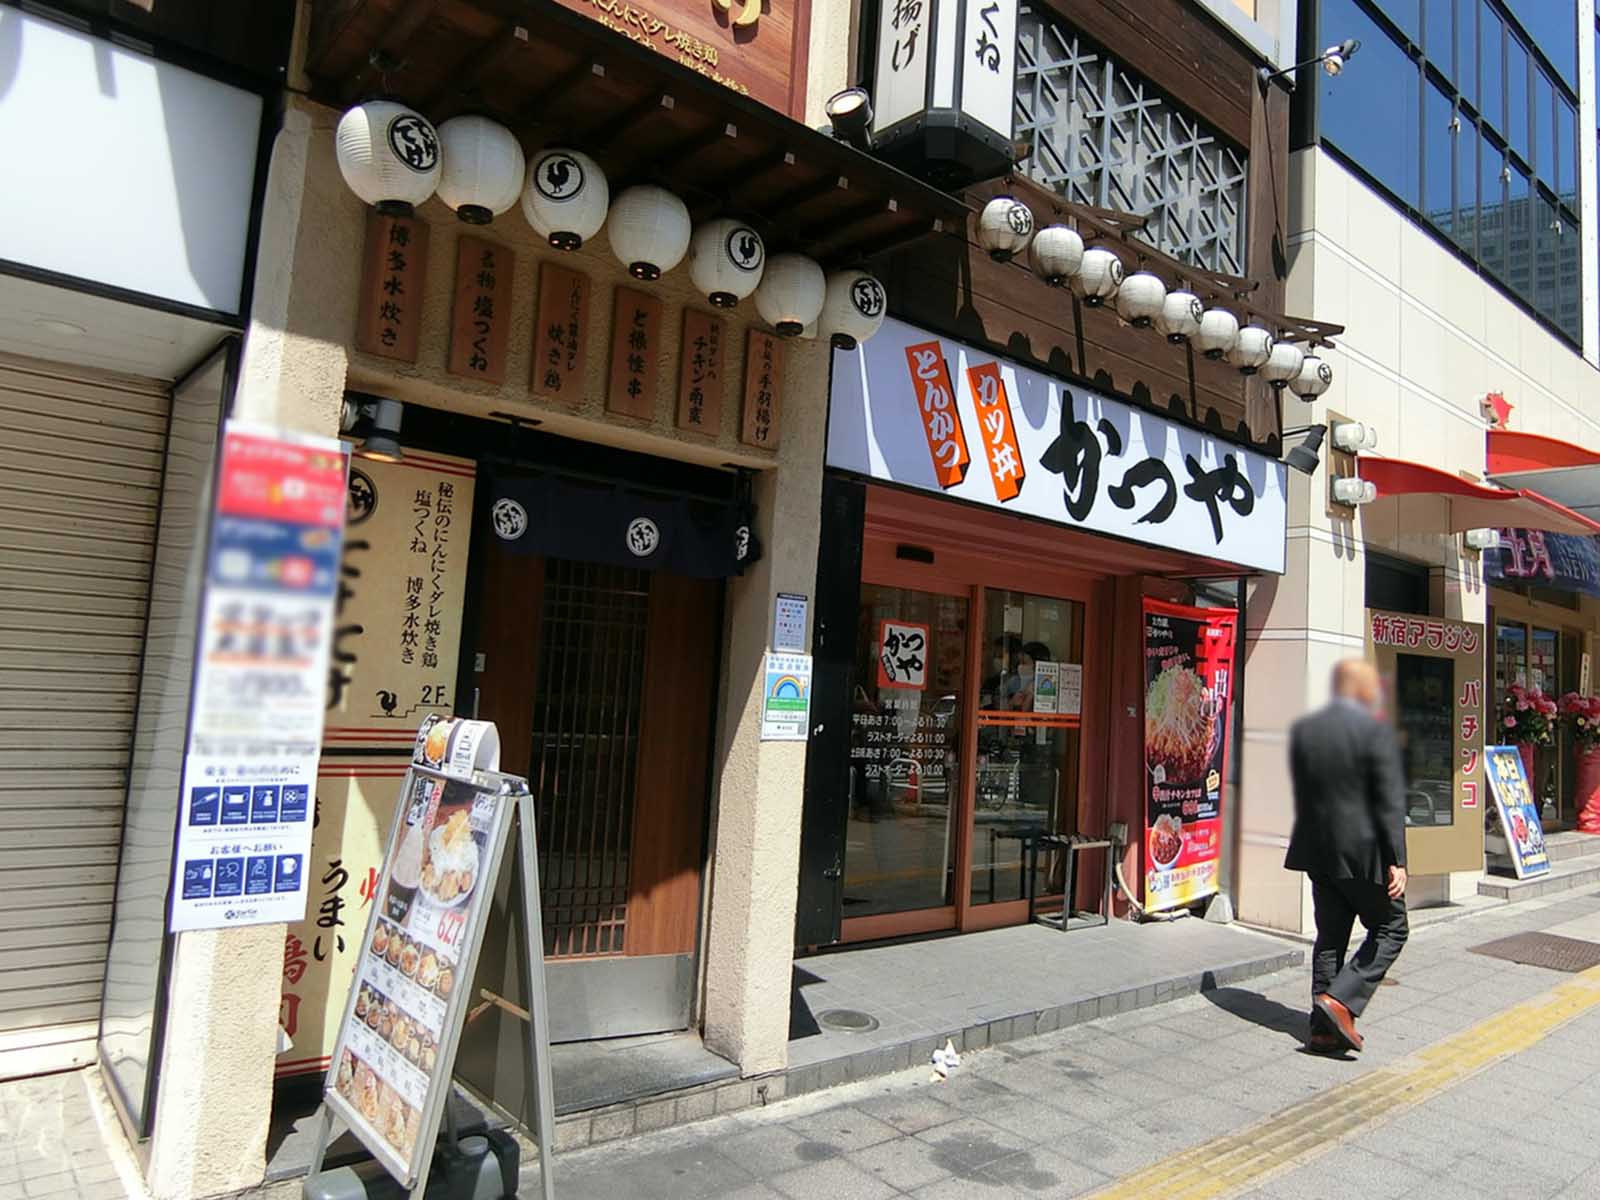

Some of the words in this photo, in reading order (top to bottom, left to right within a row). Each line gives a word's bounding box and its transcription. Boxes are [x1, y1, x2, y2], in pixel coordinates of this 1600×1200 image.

[976, 2, 1001, 74] くね
[911, 349, 962, 468] とんかつ
[976, 372, 1019, 483] カツ丼
[1039, 389, 1255, 545] かつや
[410, 489, 432, 553] 塩つくね
[401, 577, 424, 665] 博多水炊き
[421, 481, 454, 669] 秘伝のにんにくダレ焼き鶏
[883, 627, 924, 681] かつや
[1371, 613, 1479, 653] 新宿アラジン
[421, 685, 446, 704] 2F
[1460, 680, 1481, 808] パチンコ
[313, 859, 349, 962] うまい
